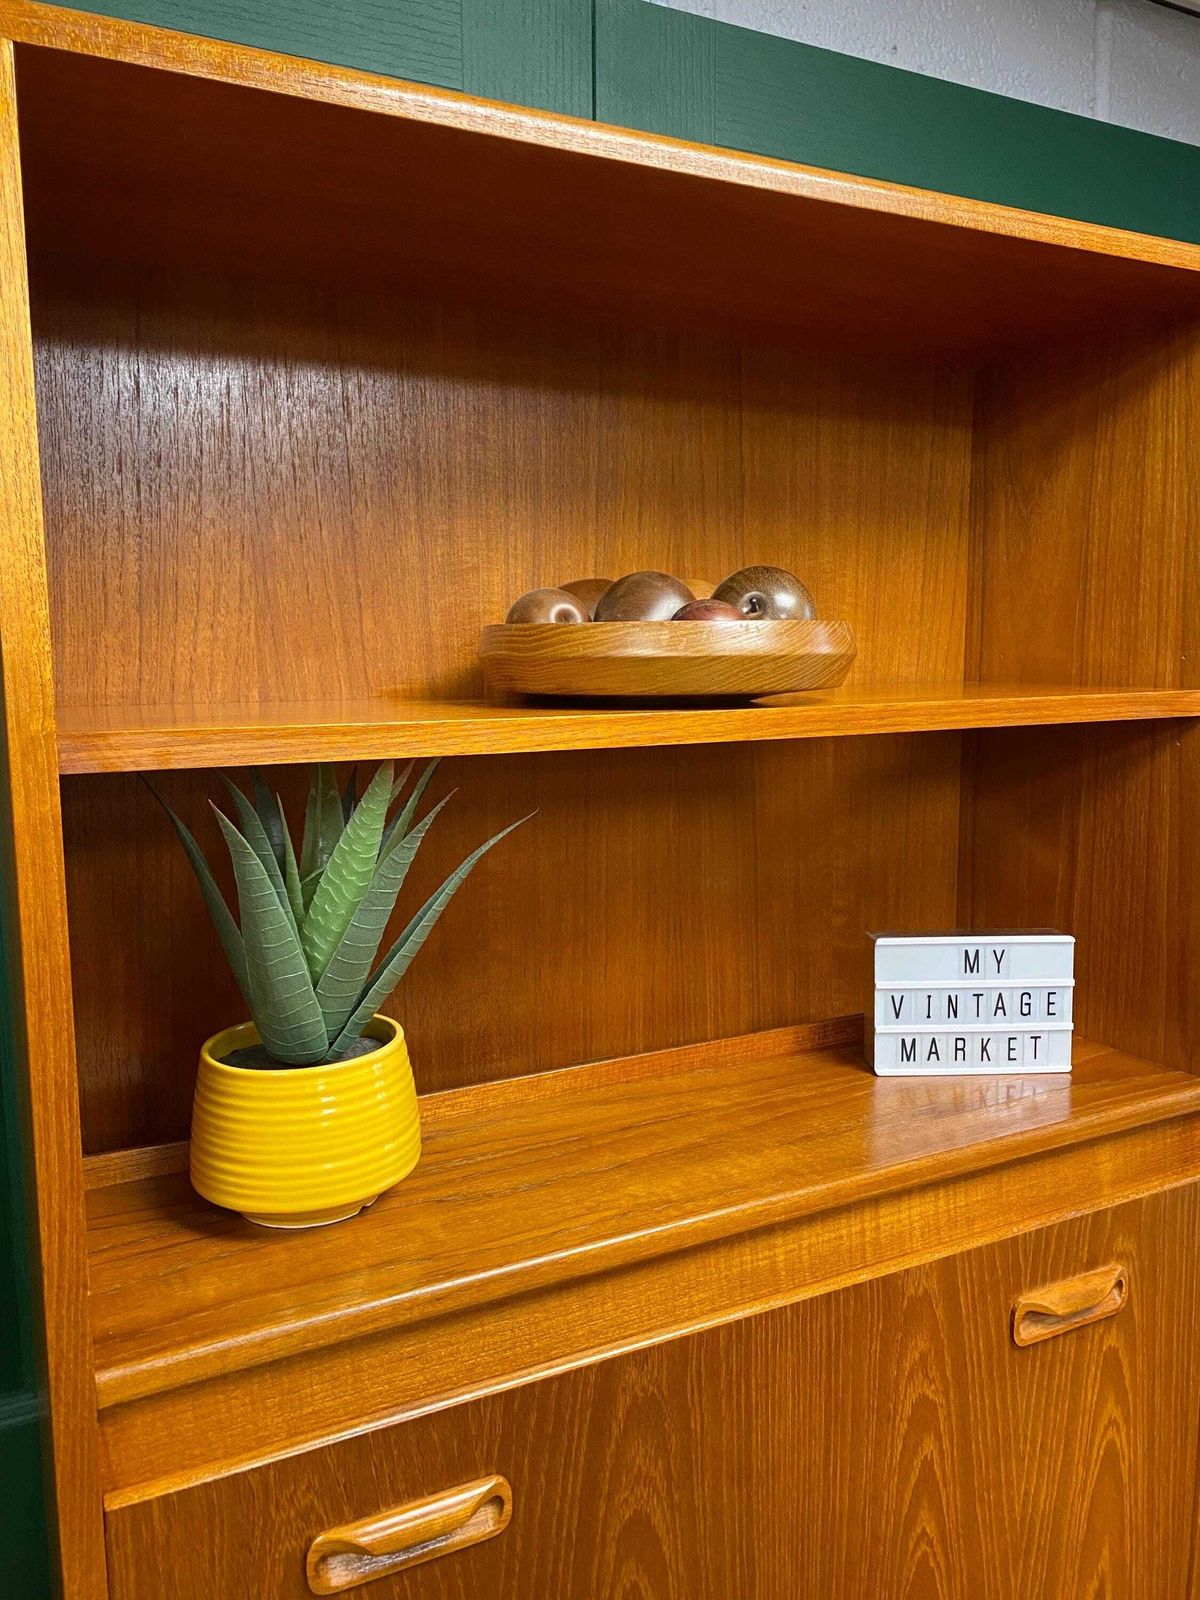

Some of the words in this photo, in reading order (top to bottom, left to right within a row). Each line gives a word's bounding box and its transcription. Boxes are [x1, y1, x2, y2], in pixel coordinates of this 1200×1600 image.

[964, 949, 1006, 974] MY
[890, 991, 1058, 1020] VINTAGE
[900, 1036, 1042, 1062] MARKET
